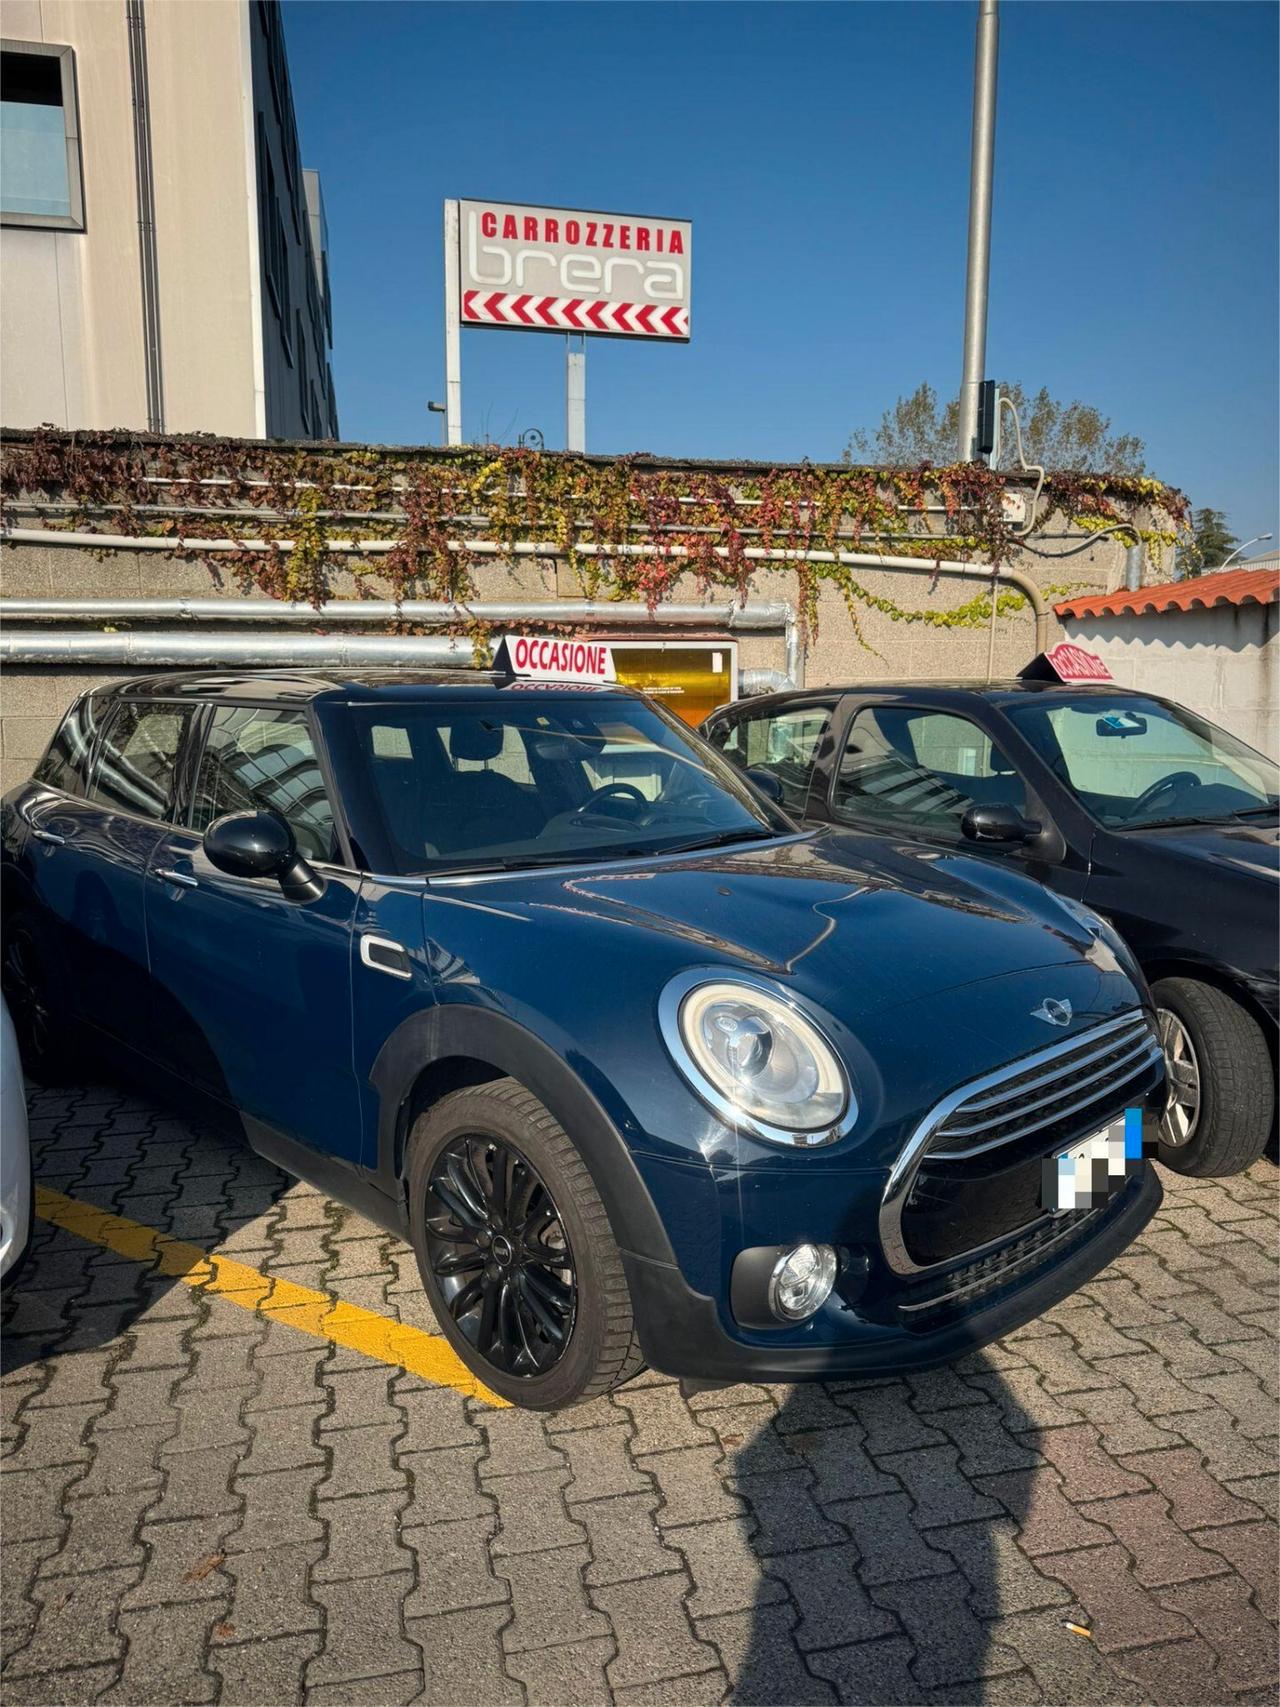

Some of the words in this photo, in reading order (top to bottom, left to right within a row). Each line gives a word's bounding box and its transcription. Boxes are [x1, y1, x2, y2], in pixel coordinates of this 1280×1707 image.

[481, 211, 684, 254] CARROZZERIA
[468, 210, 684, 300] brera
[515, 638, 607, 675] OCCASIONE
